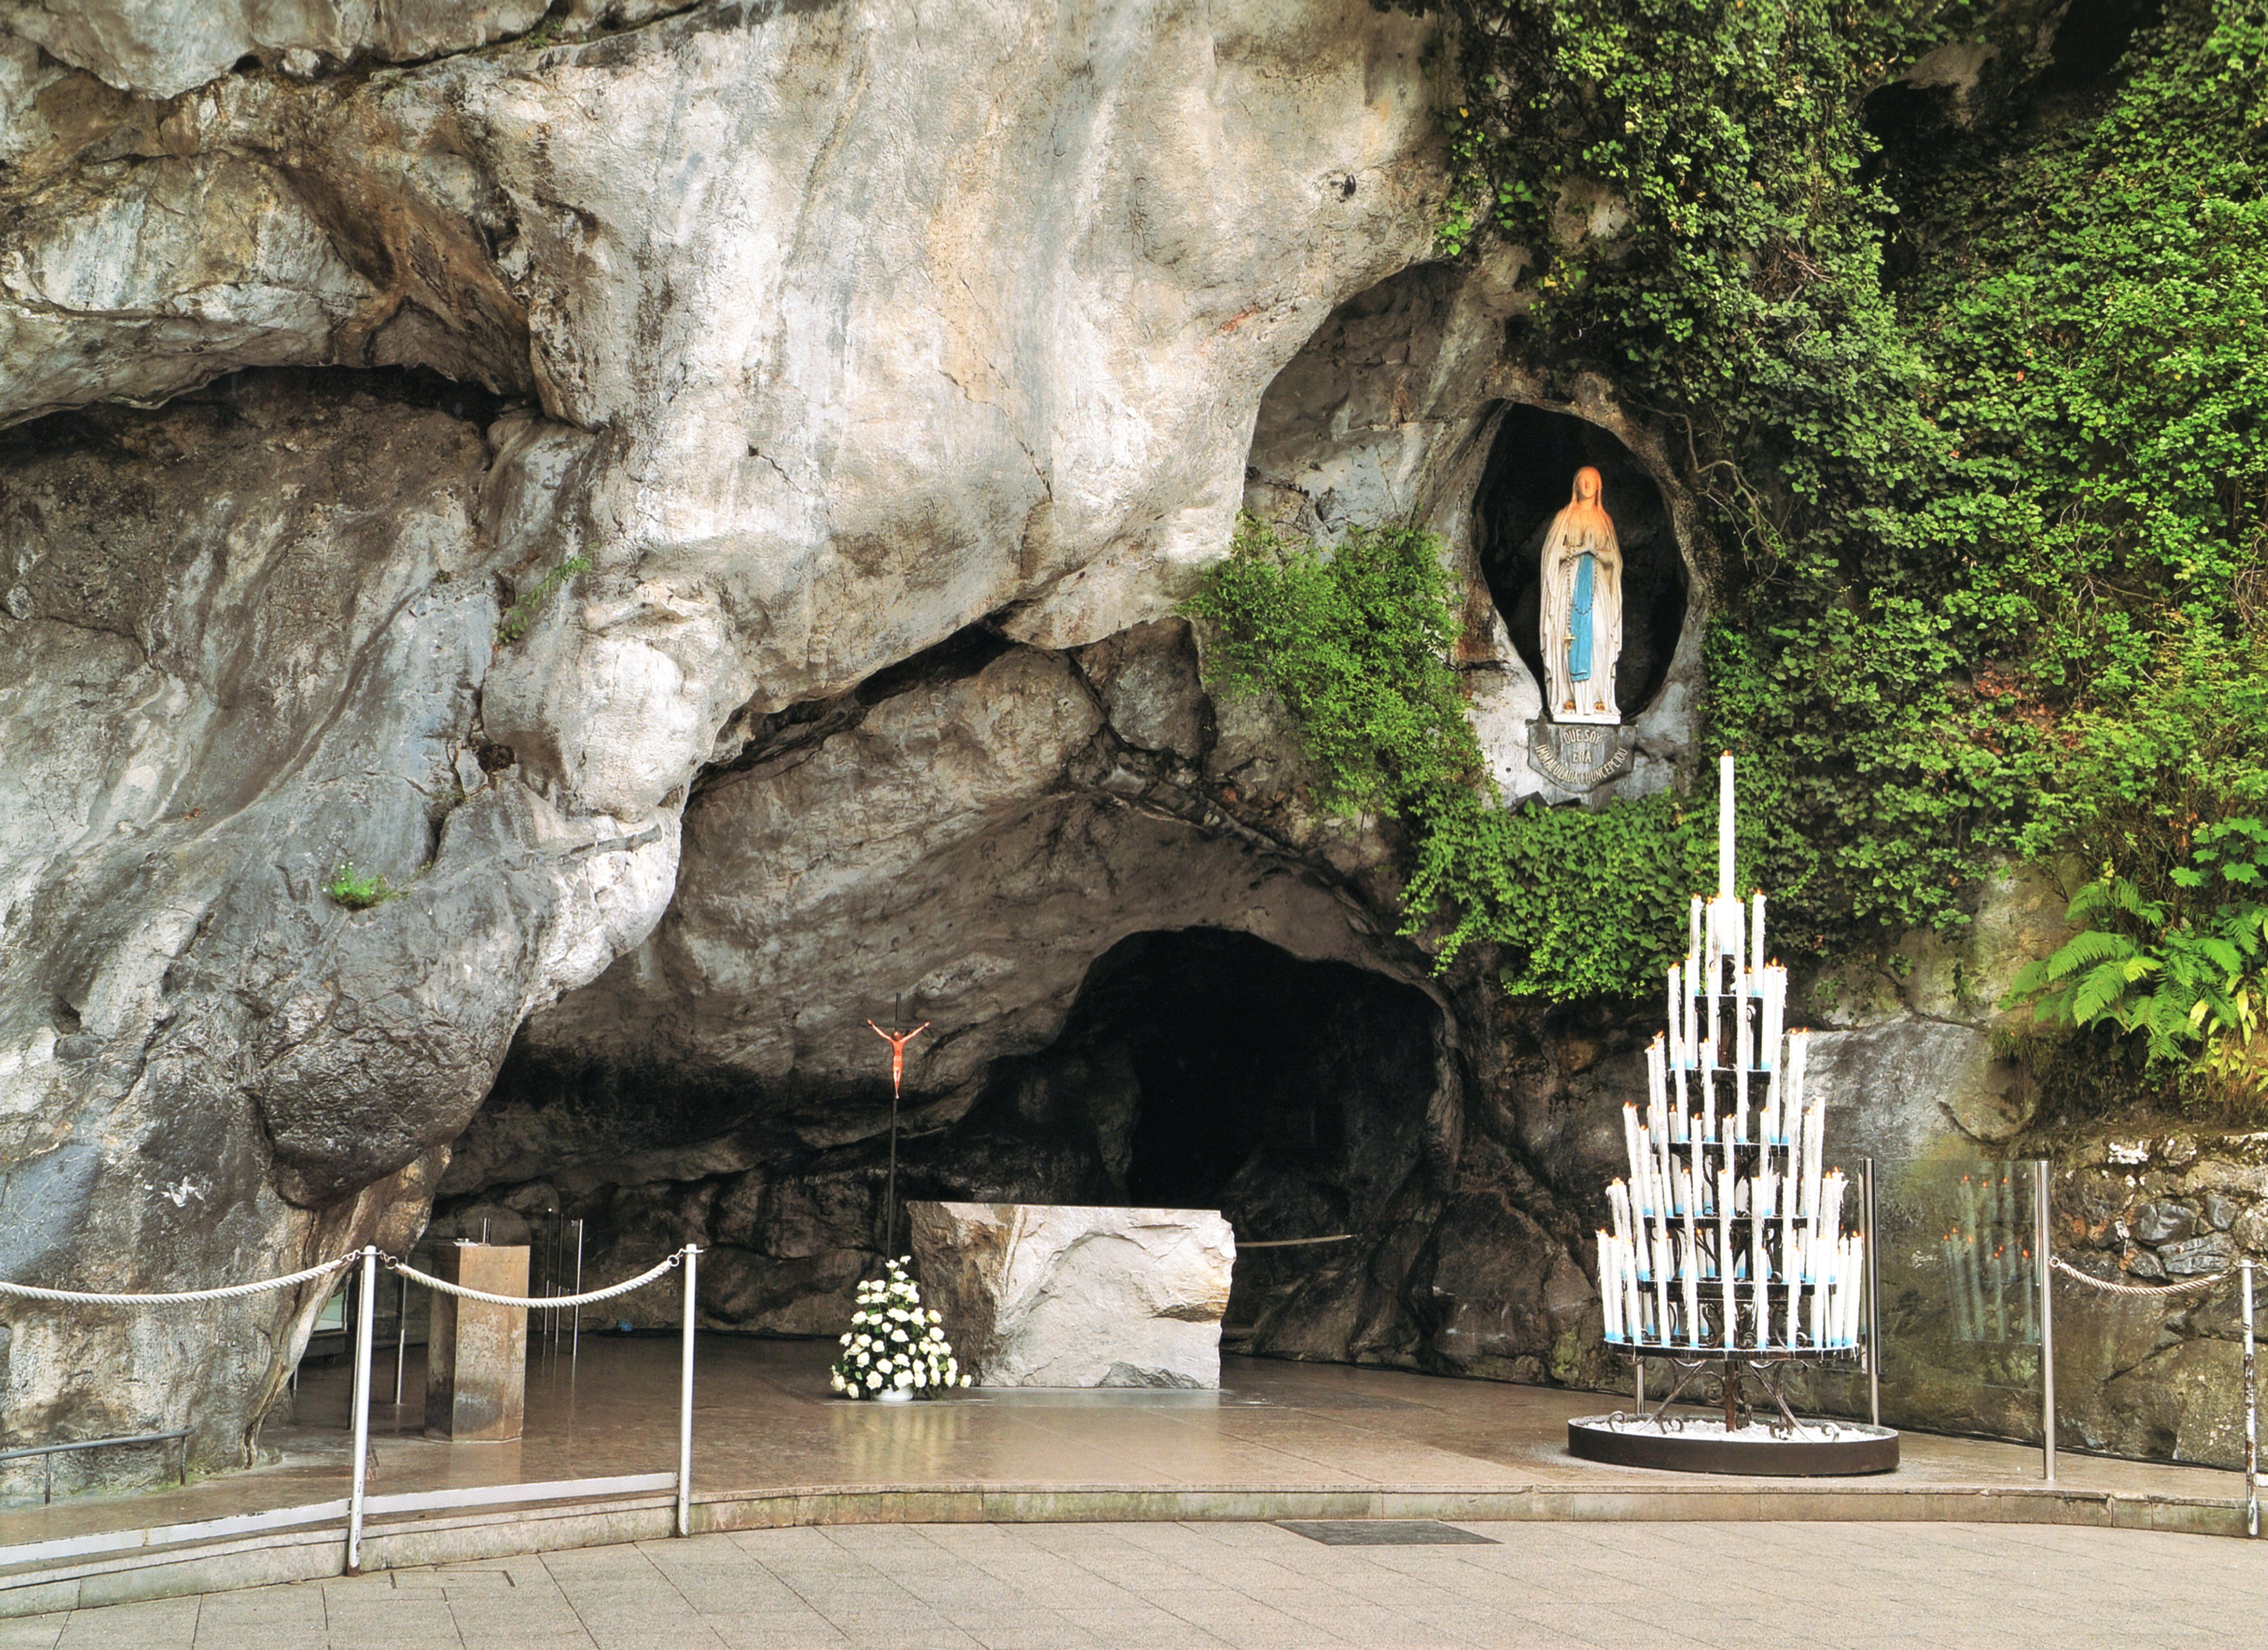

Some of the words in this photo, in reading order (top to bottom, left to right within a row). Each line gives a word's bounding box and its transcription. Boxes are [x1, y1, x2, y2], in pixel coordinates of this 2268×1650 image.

[1583, 730, 1603, 745] SOY
[1572, 749, 1592, 763] ERA
[1535, 744, 1578, 783] IMMACULADA
[1580, 747, 1628, 784] COUNCEPCIOU
